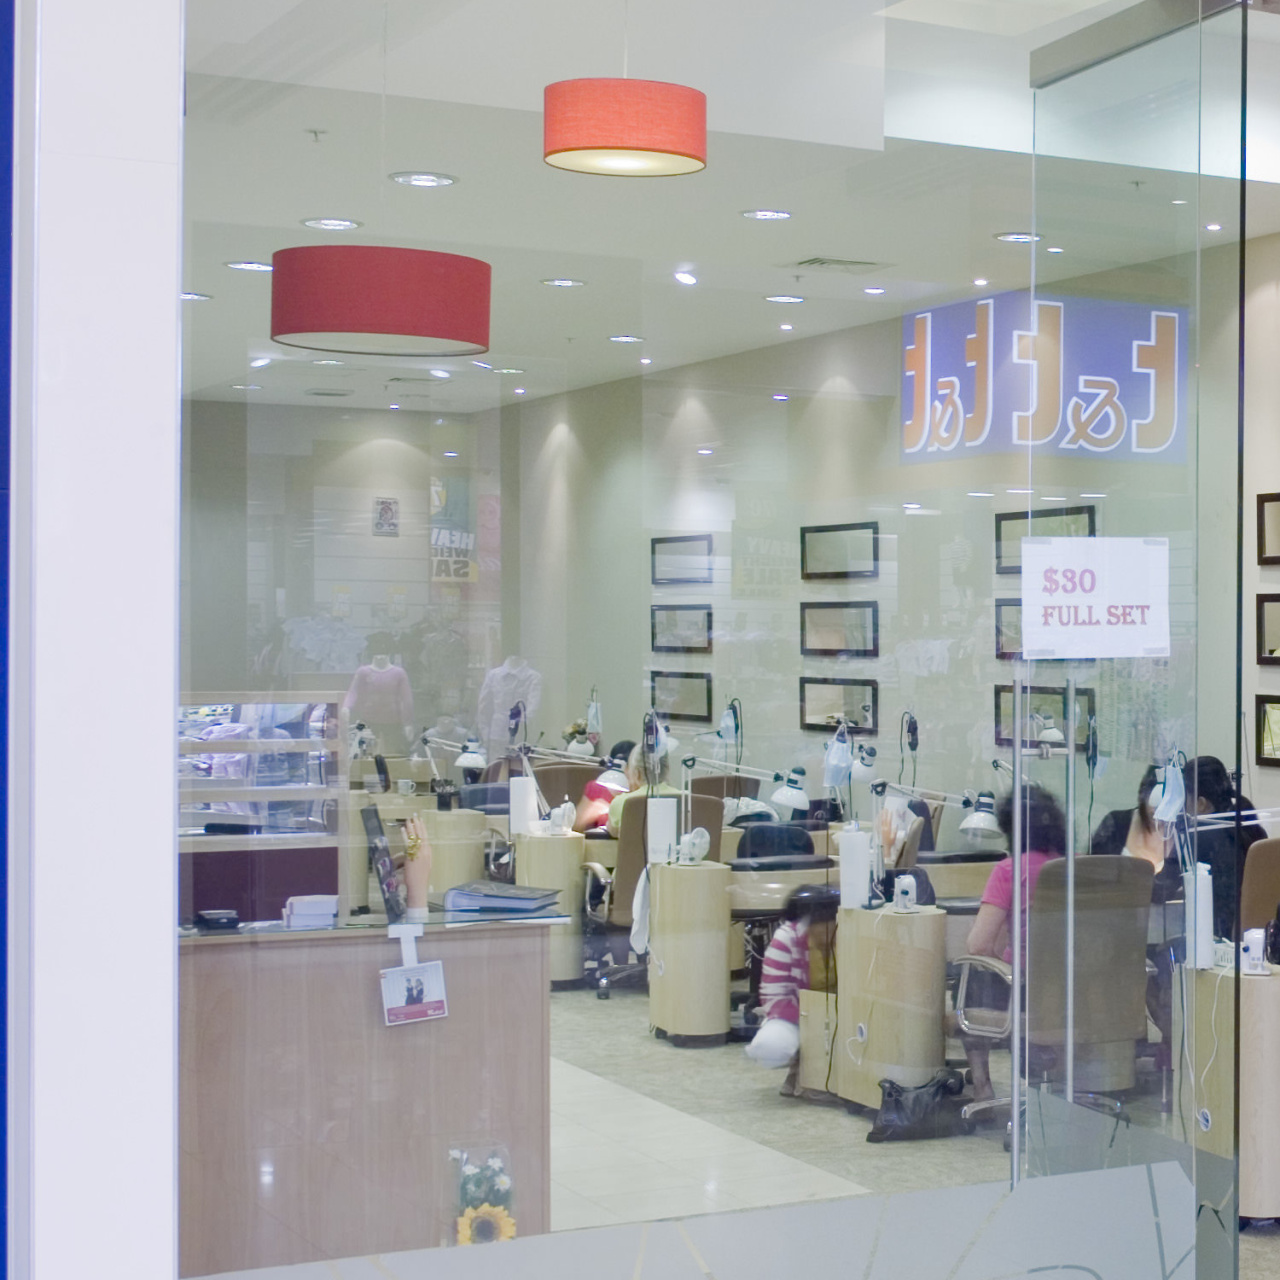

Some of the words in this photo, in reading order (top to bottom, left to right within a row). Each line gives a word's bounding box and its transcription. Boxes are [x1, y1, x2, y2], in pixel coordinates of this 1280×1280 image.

[1041, 567, 1097, 596] $30
[1042, 605, 1101, 626] FULL
[1106, 604, 1150, 626] SET
